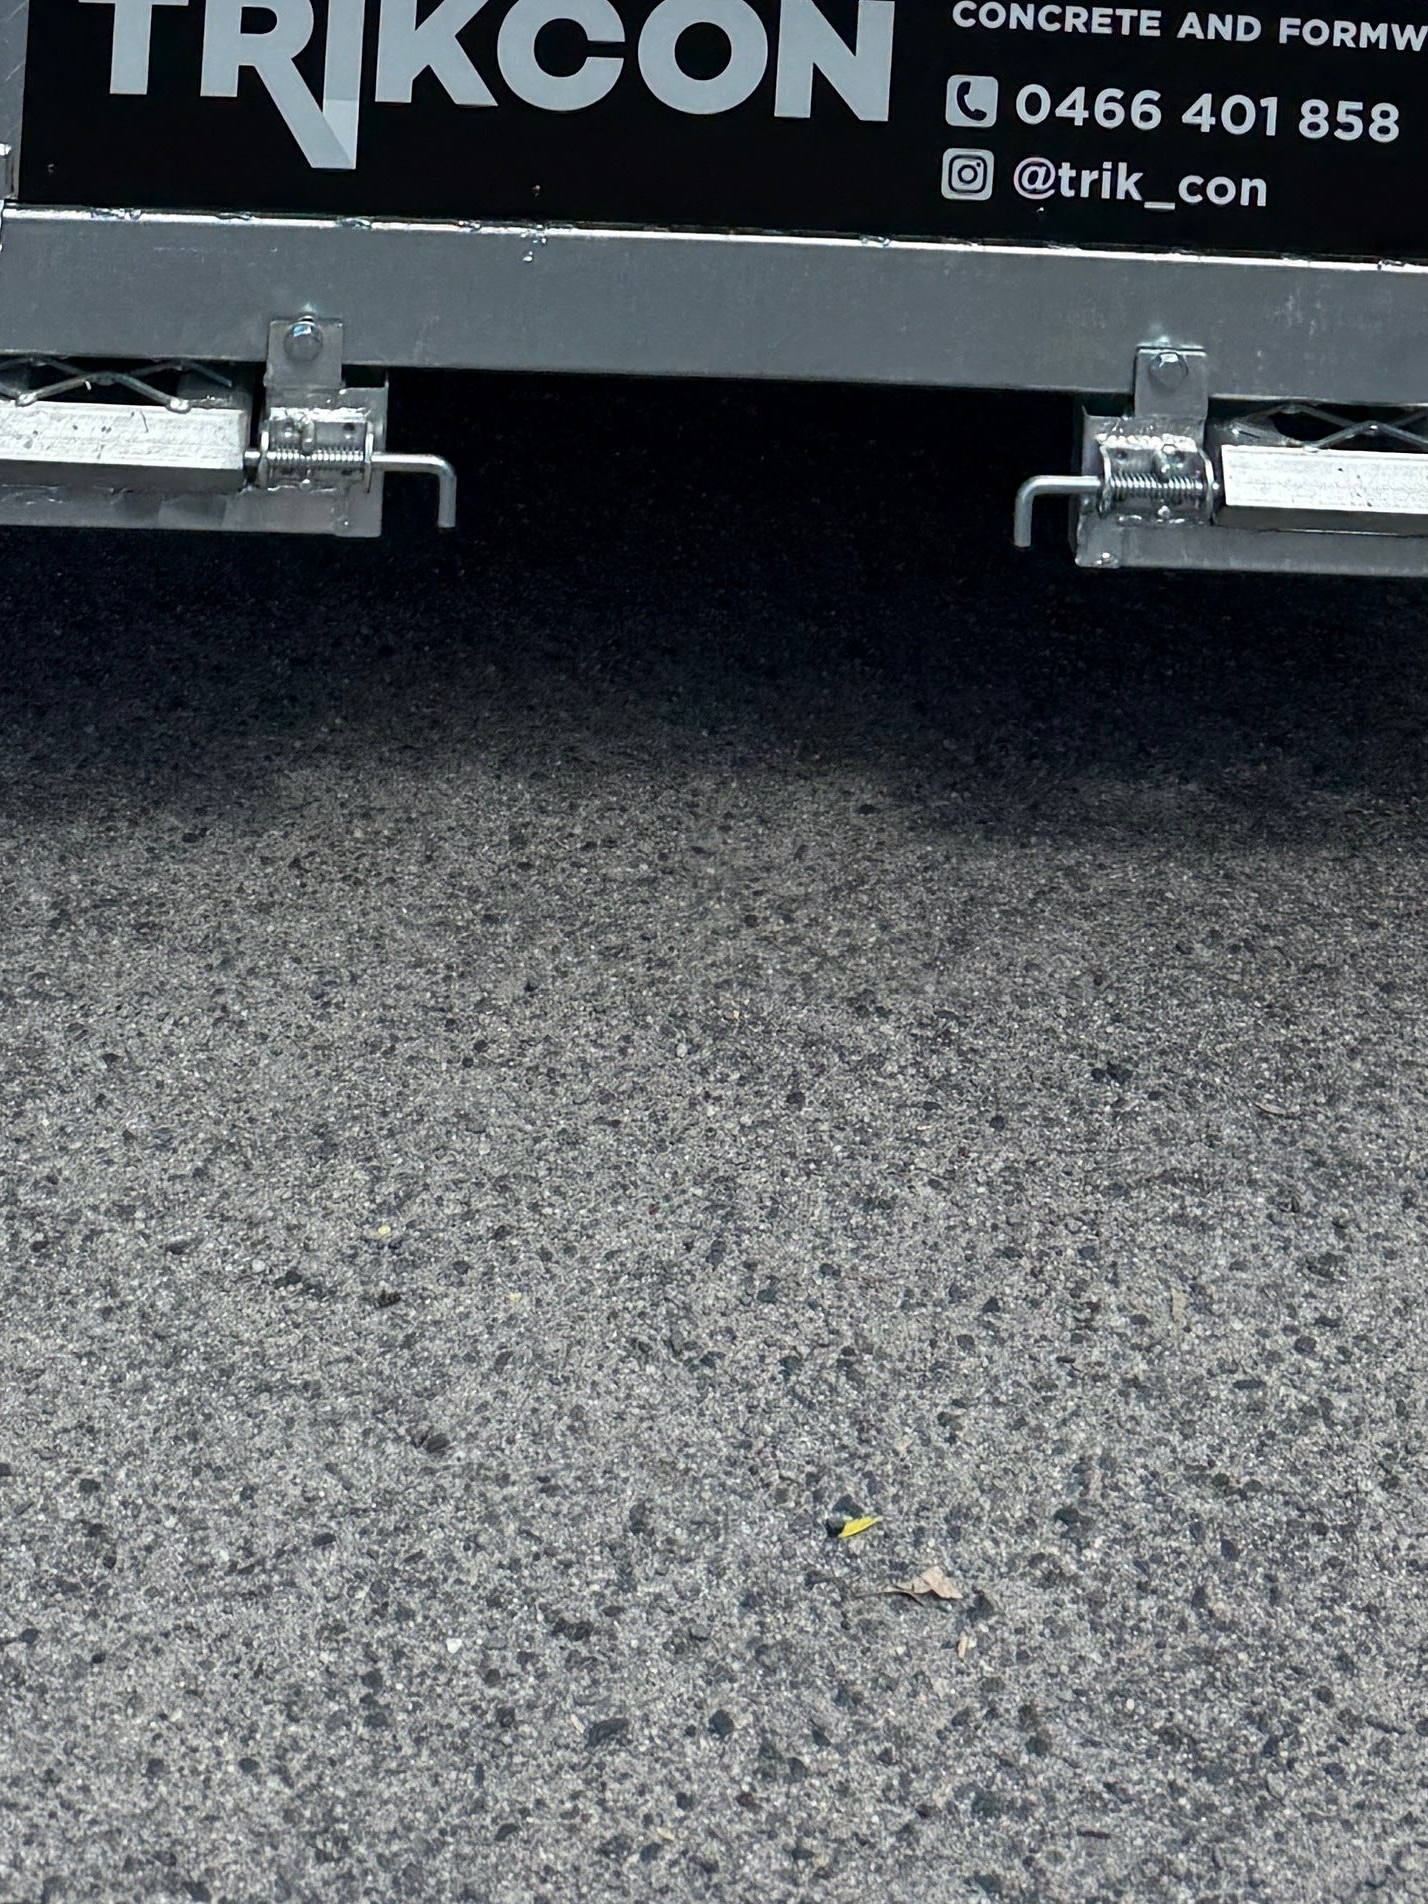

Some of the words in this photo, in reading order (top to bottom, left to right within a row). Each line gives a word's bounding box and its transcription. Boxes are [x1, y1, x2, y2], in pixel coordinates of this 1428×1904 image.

[952, 0, 1162, 38] CONCRETE
[1176, 11, 1262, 42] AND
[1015, 83, 1162, 132] 0466
[1181, 93, 1277, 137] 401
[1298, 98, 1401, 144] 858
[1013, 156, 1267, 211] @trik_con
